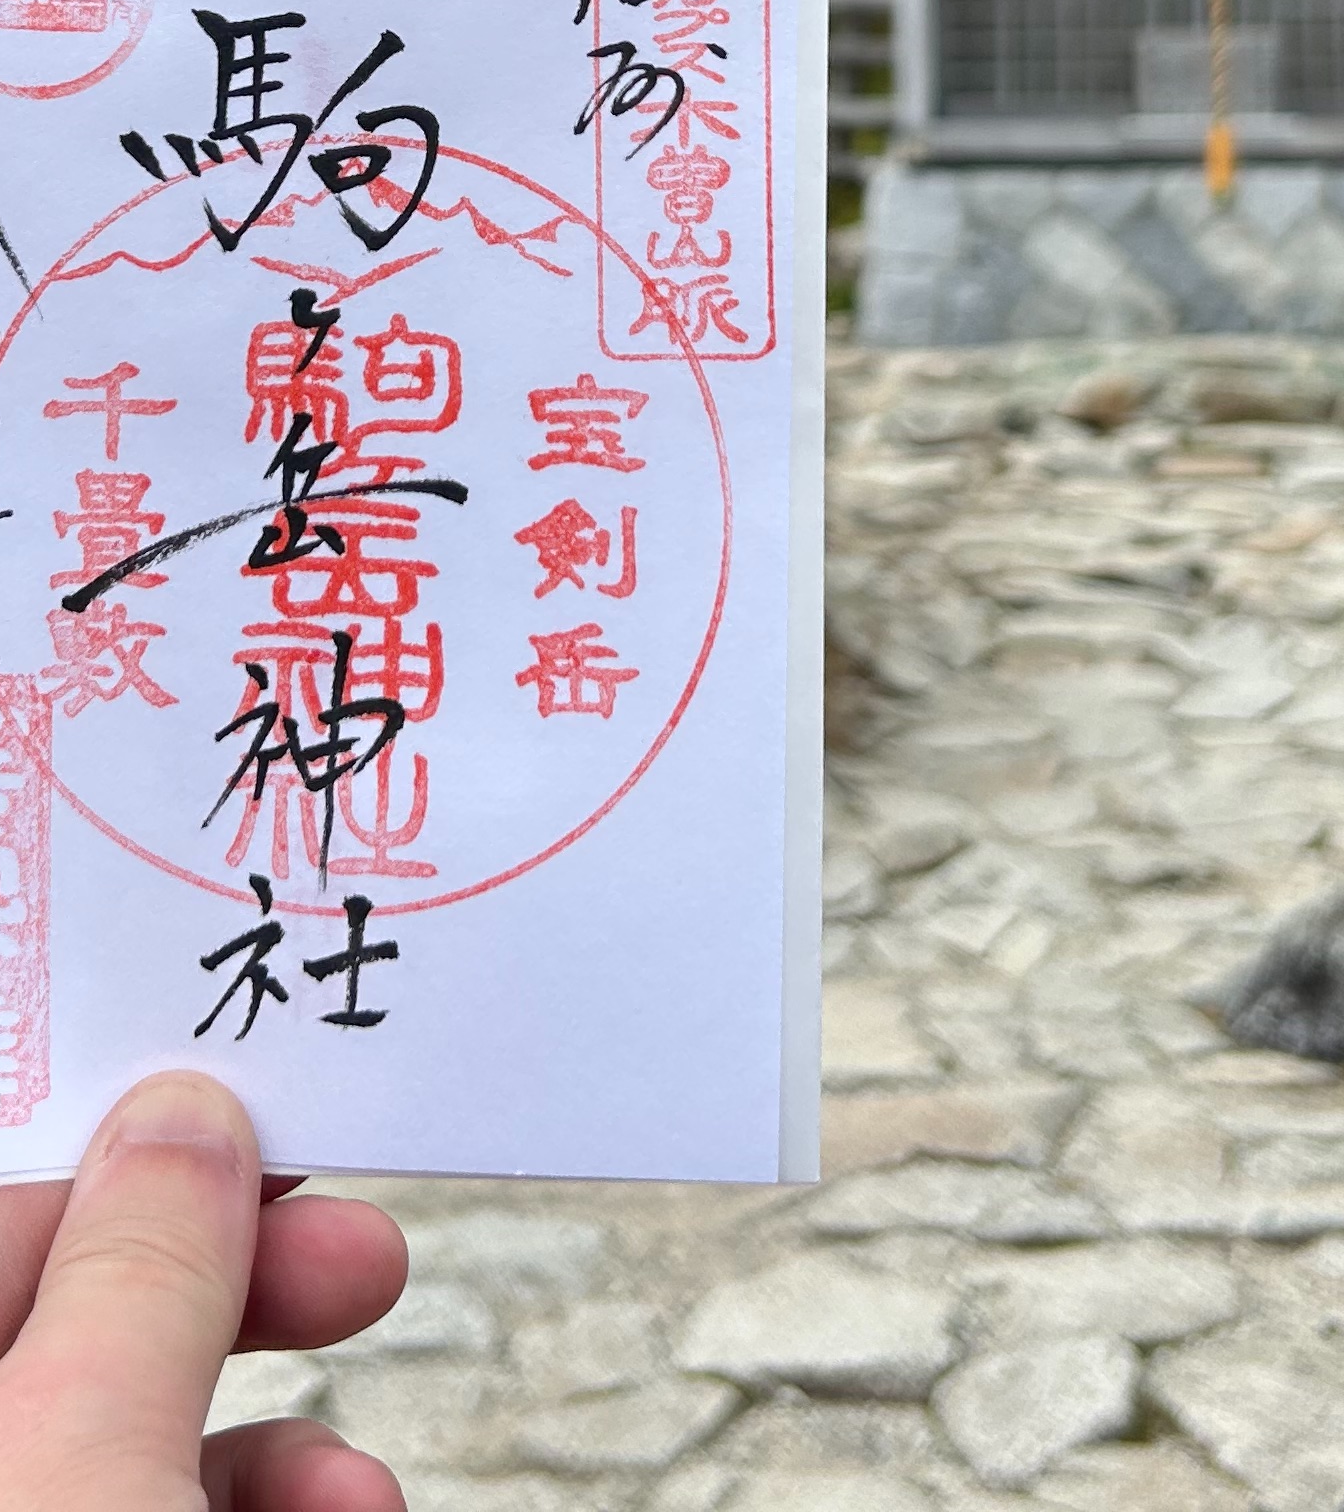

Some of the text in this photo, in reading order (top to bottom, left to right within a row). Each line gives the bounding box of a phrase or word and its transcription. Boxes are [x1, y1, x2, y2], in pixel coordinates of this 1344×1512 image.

[42, 361, 179, 719] 千畳敷
[513, 373, 649, 719] 宝剣岳
